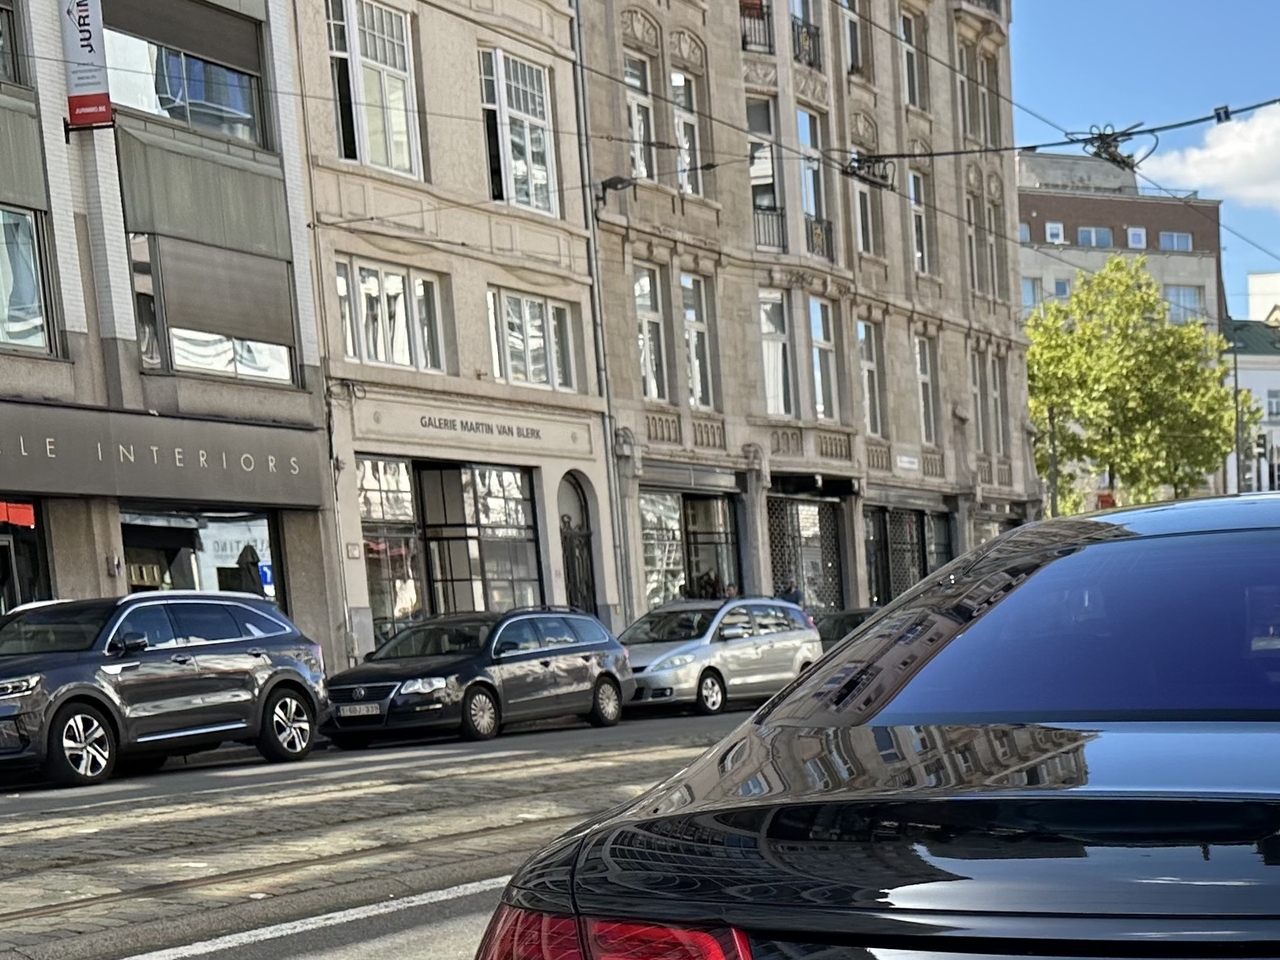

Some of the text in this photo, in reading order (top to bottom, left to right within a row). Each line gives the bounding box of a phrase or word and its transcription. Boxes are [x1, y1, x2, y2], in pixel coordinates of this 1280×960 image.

[420, 416, 542, 440] GALERIE MARTIN VAN BLERK
[0, 435, 300, 475] LE INTERIORS
